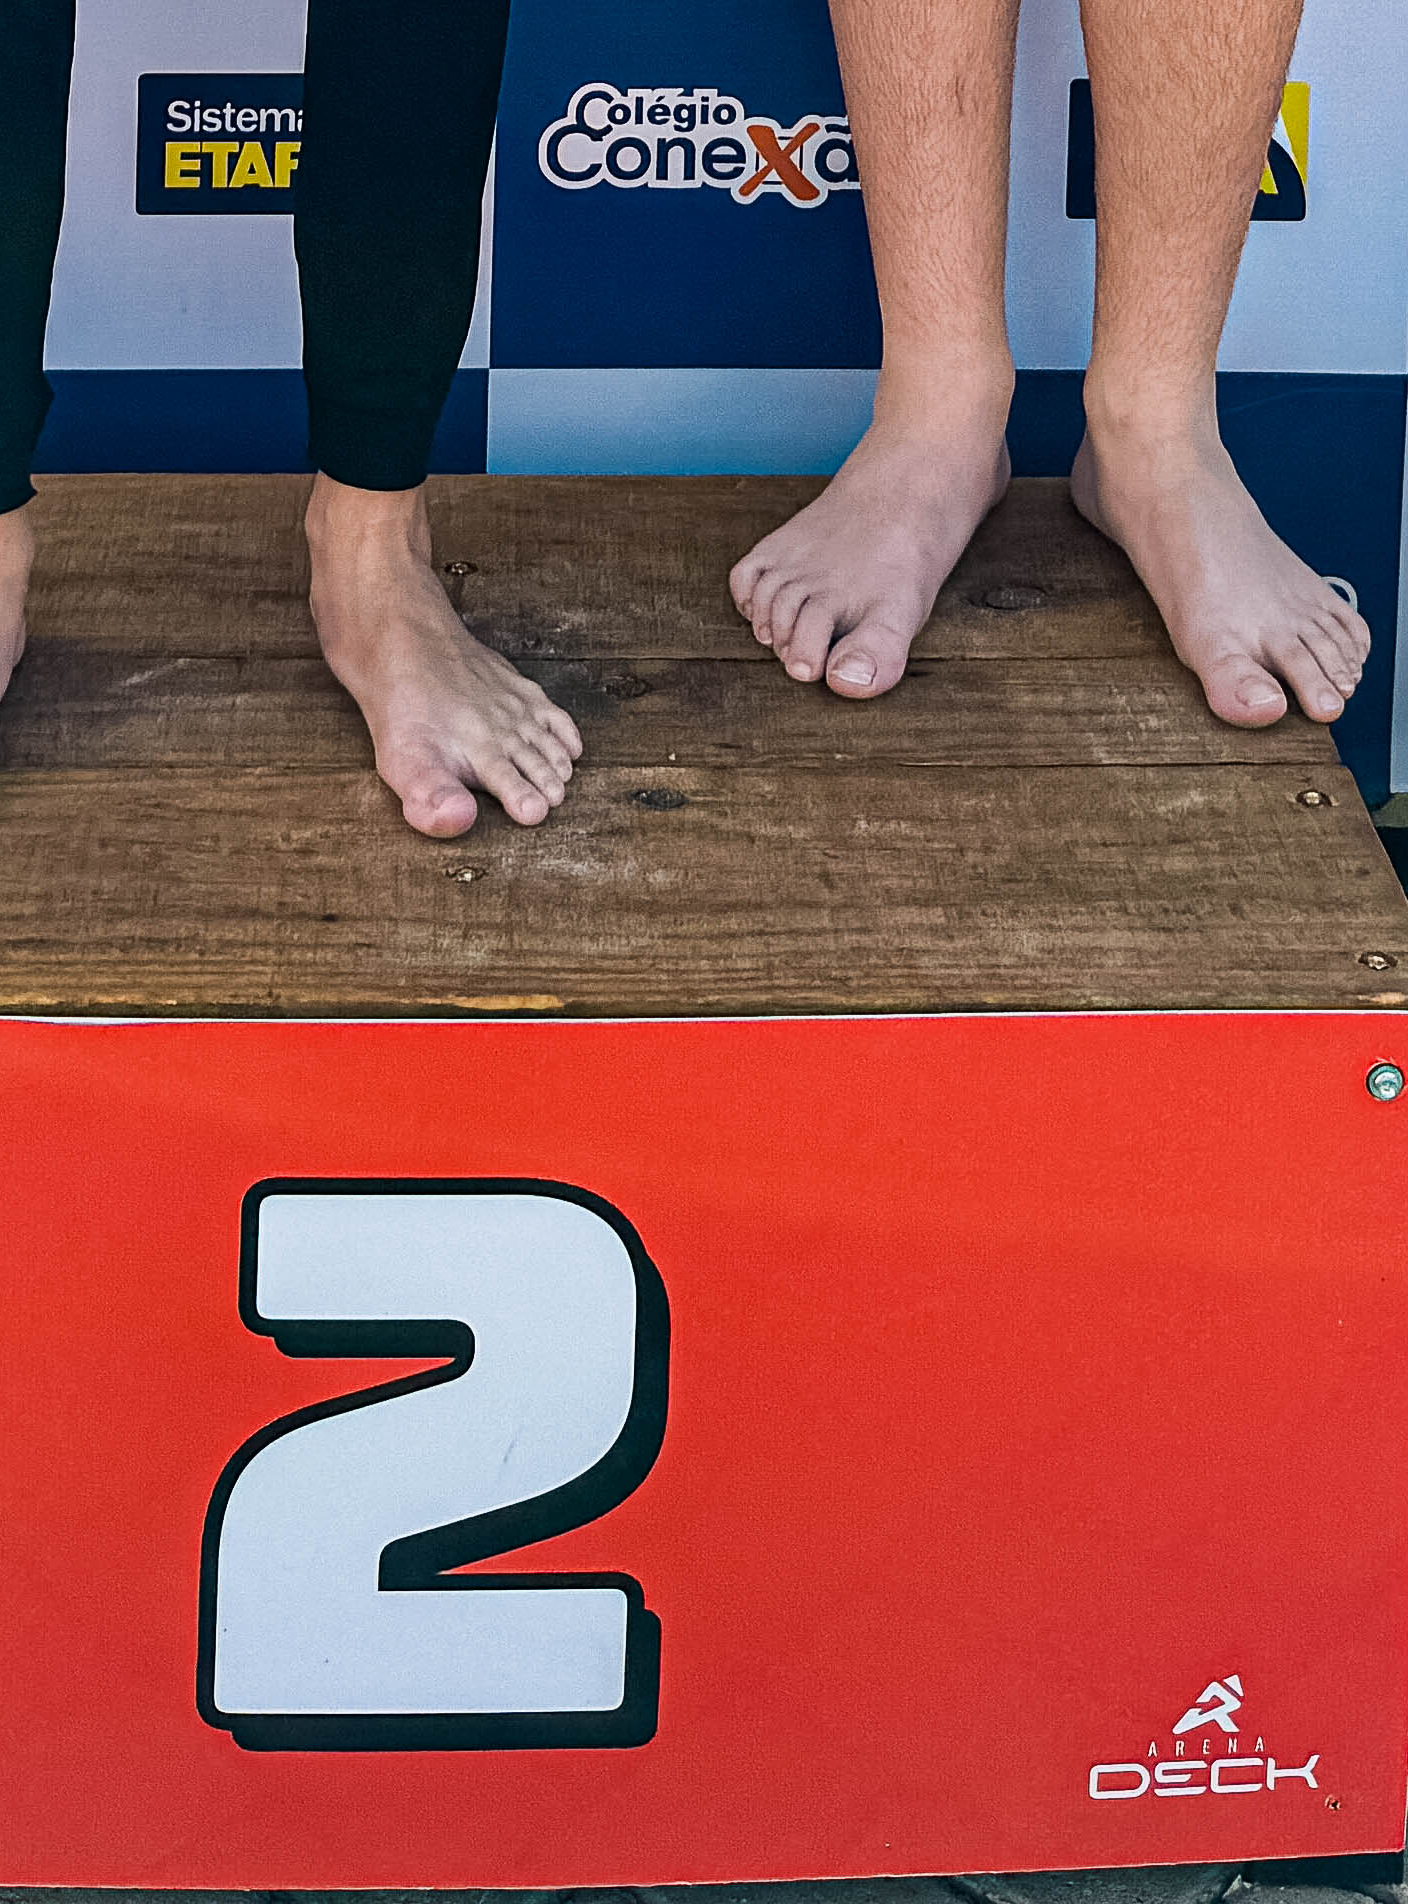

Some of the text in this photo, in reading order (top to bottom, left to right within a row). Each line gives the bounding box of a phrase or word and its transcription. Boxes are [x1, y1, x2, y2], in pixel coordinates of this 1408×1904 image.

[579, 87, 737, 133] Colégio
[201, 1179, 657, 1737] 2
[1148, 1736, 1264, 1757] ARENA
[1089, 1754, 1321, 1800] DECK
